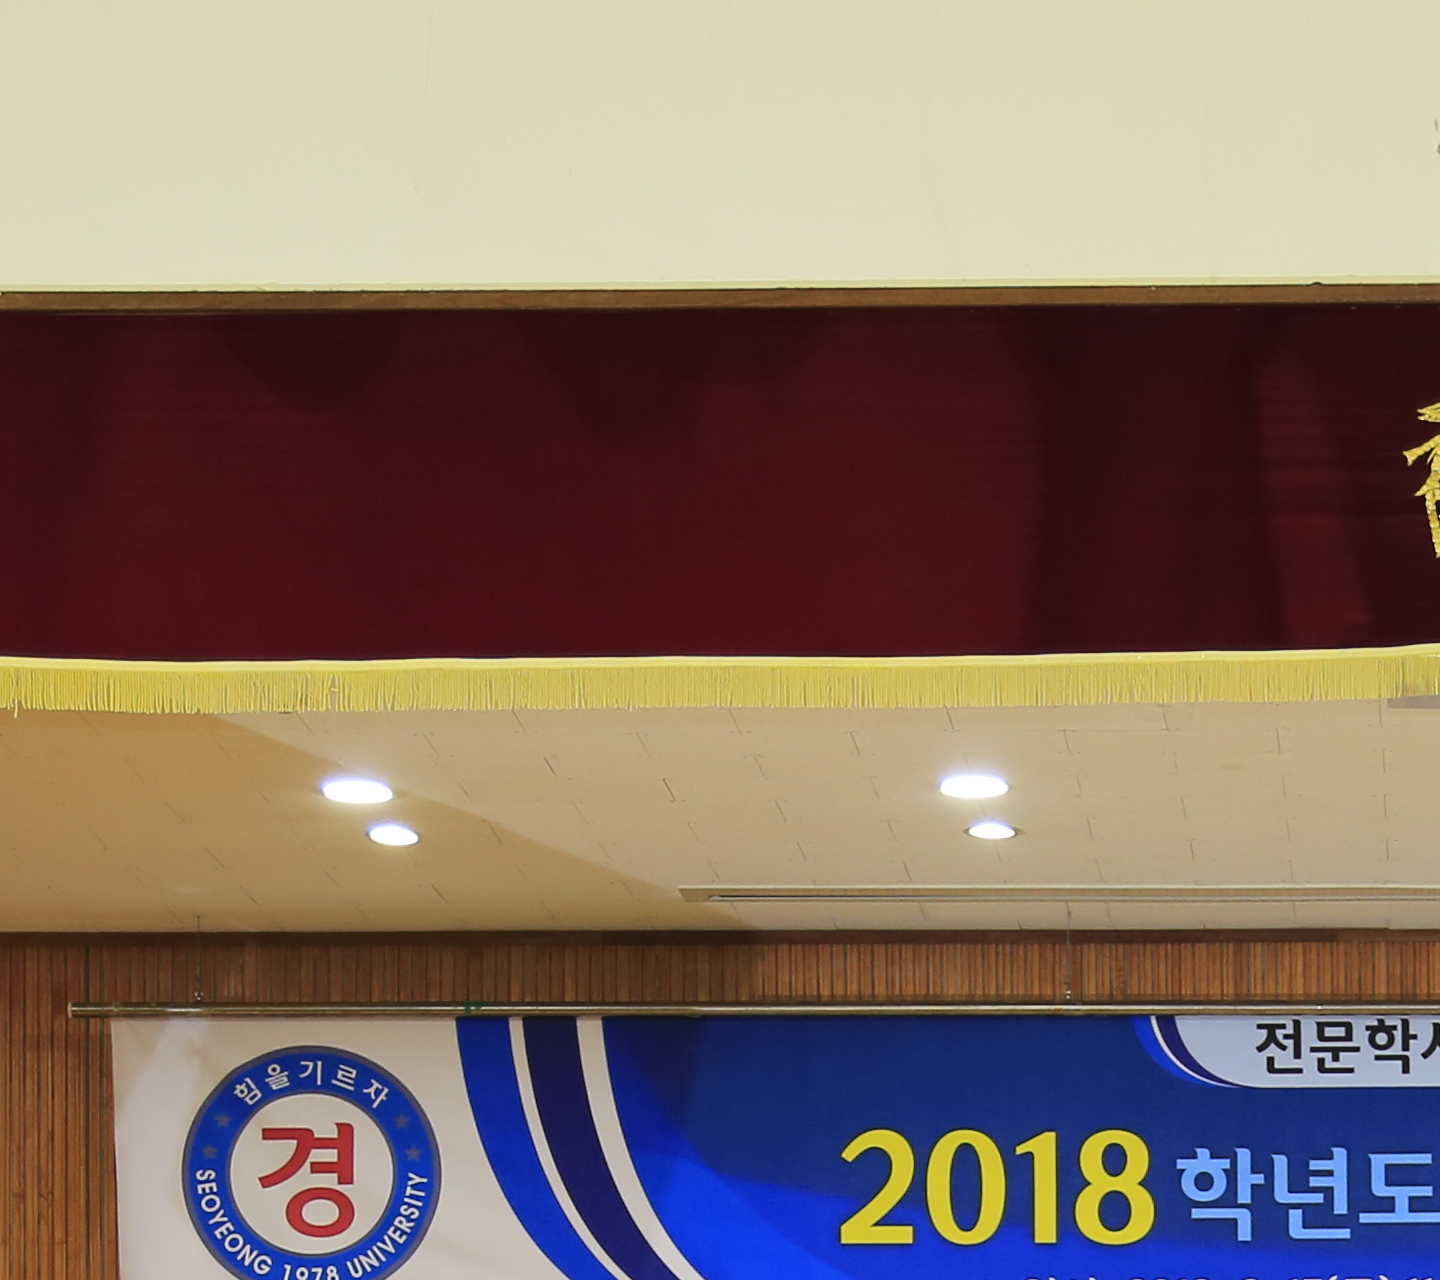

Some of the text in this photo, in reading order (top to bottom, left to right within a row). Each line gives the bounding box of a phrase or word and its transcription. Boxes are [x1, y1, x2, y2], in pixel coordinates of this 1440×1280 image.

[195, 1168, 273, 1275] SEOYEONG
[345, 1171, 429, 1280] UNIVERSITY
[257, 1121, 356, 1238] 경
[838, 1128, 1157, 1246] 2018
